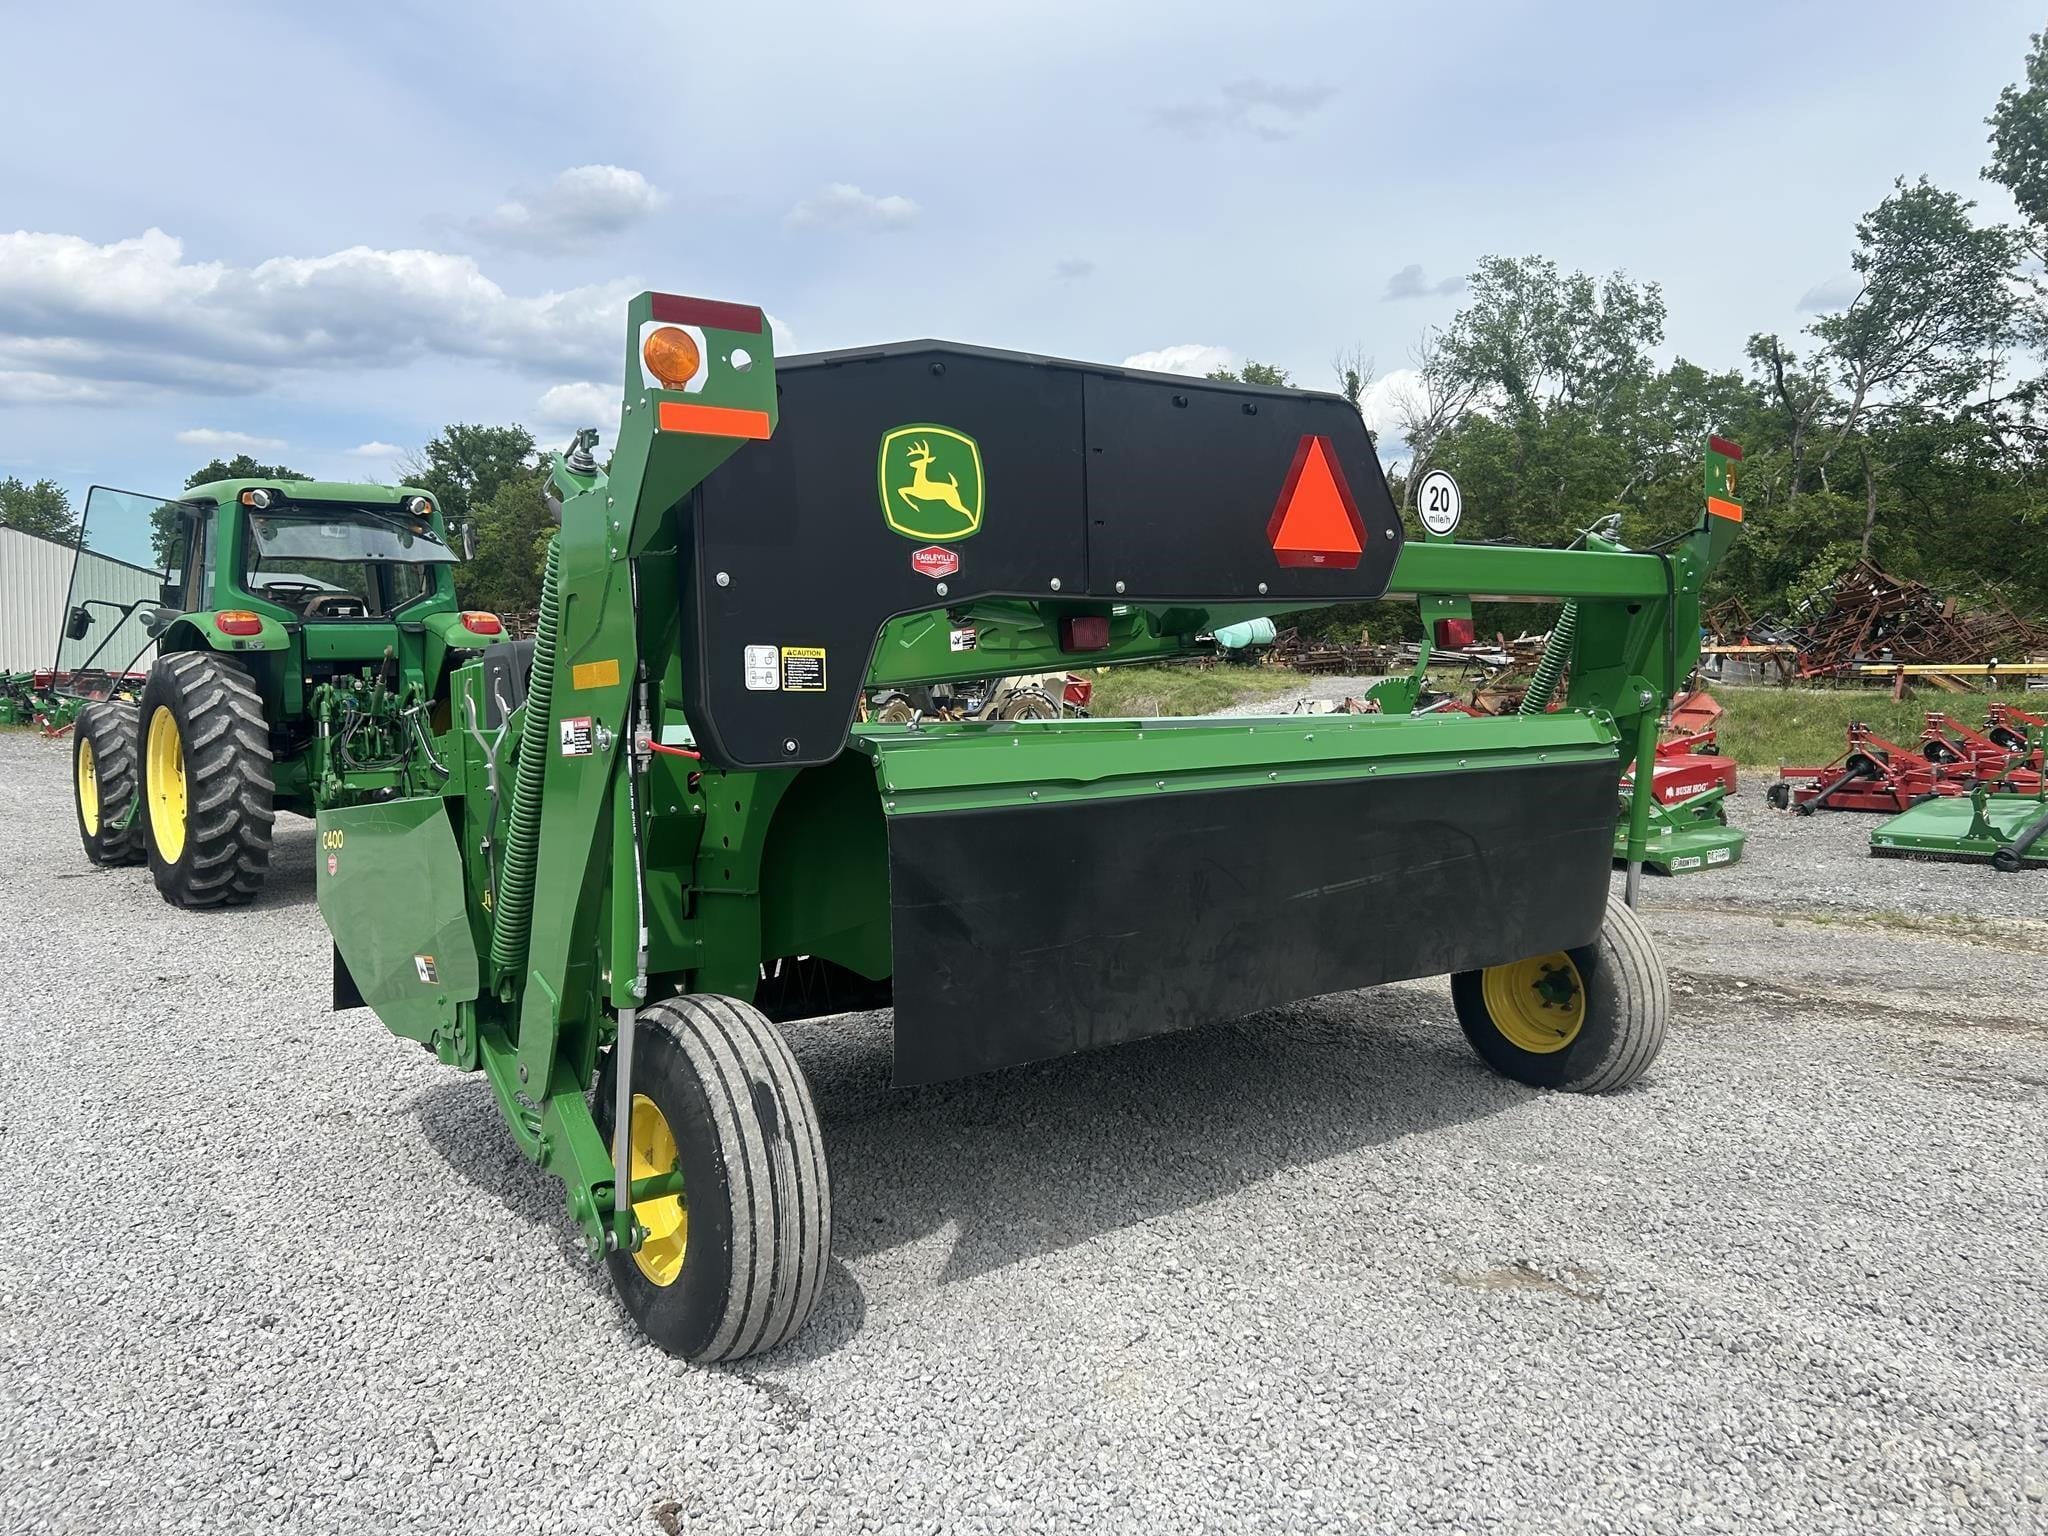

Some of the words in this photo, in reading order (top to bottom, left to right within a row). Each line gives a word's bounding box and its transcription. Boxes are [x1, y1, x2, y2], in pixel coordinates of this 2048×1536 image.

[1430, 486, 1450, 512] 20
[1429, 514, 1450, 524] mile/h
[1675, 785, 1692, 796] BUSH
[1692, 783, 1706, 793] HOG
[323, 830, 344, 850] C400
